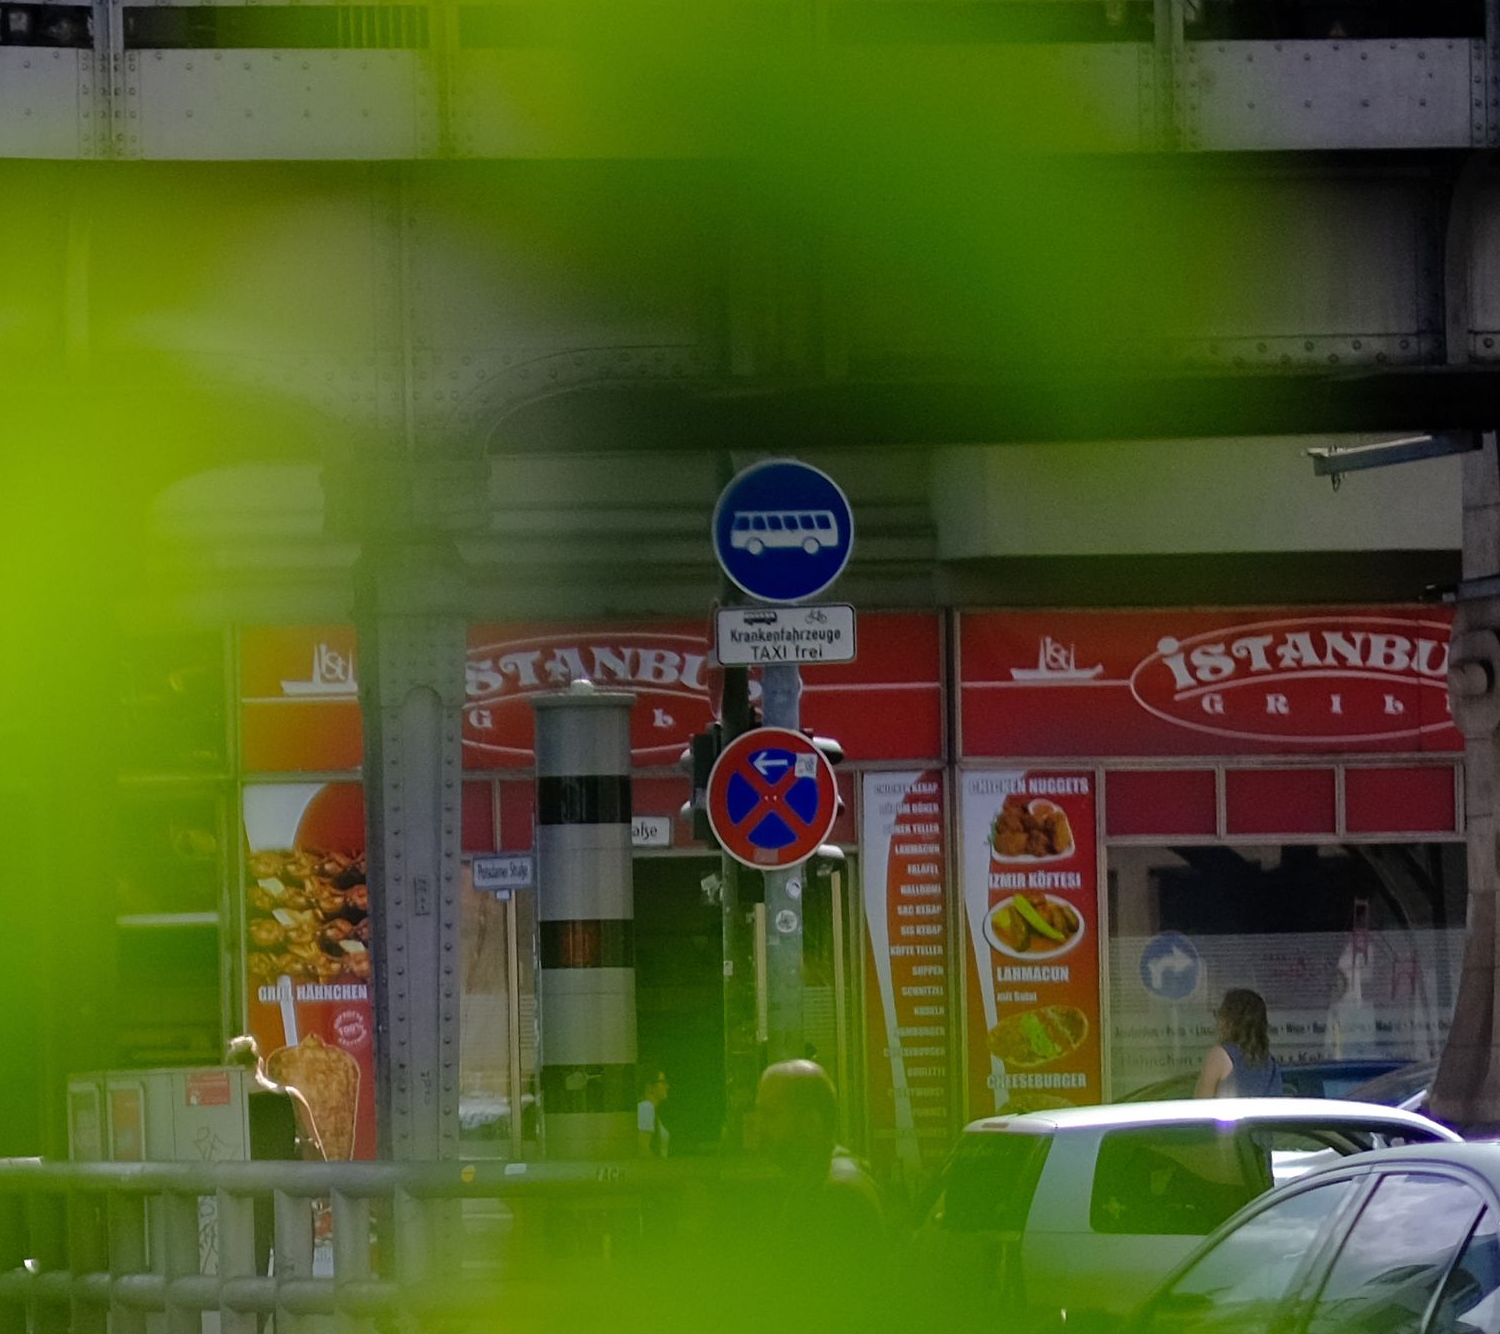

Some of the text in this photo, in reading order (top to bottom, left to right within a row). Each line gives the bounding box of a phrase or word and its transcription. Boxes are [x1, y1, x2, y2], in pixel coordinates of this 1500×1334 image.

[730, 627, 841, 644] Krankenfahrzeuge
[751, 644, 823, 660] TAXI frei
[1029, 777, 1089, 794] NUGGETS
[997, 966, 1069, 982] LAHMACUN
[987, 1073, 1087, 1089] CHEESEBURGER
